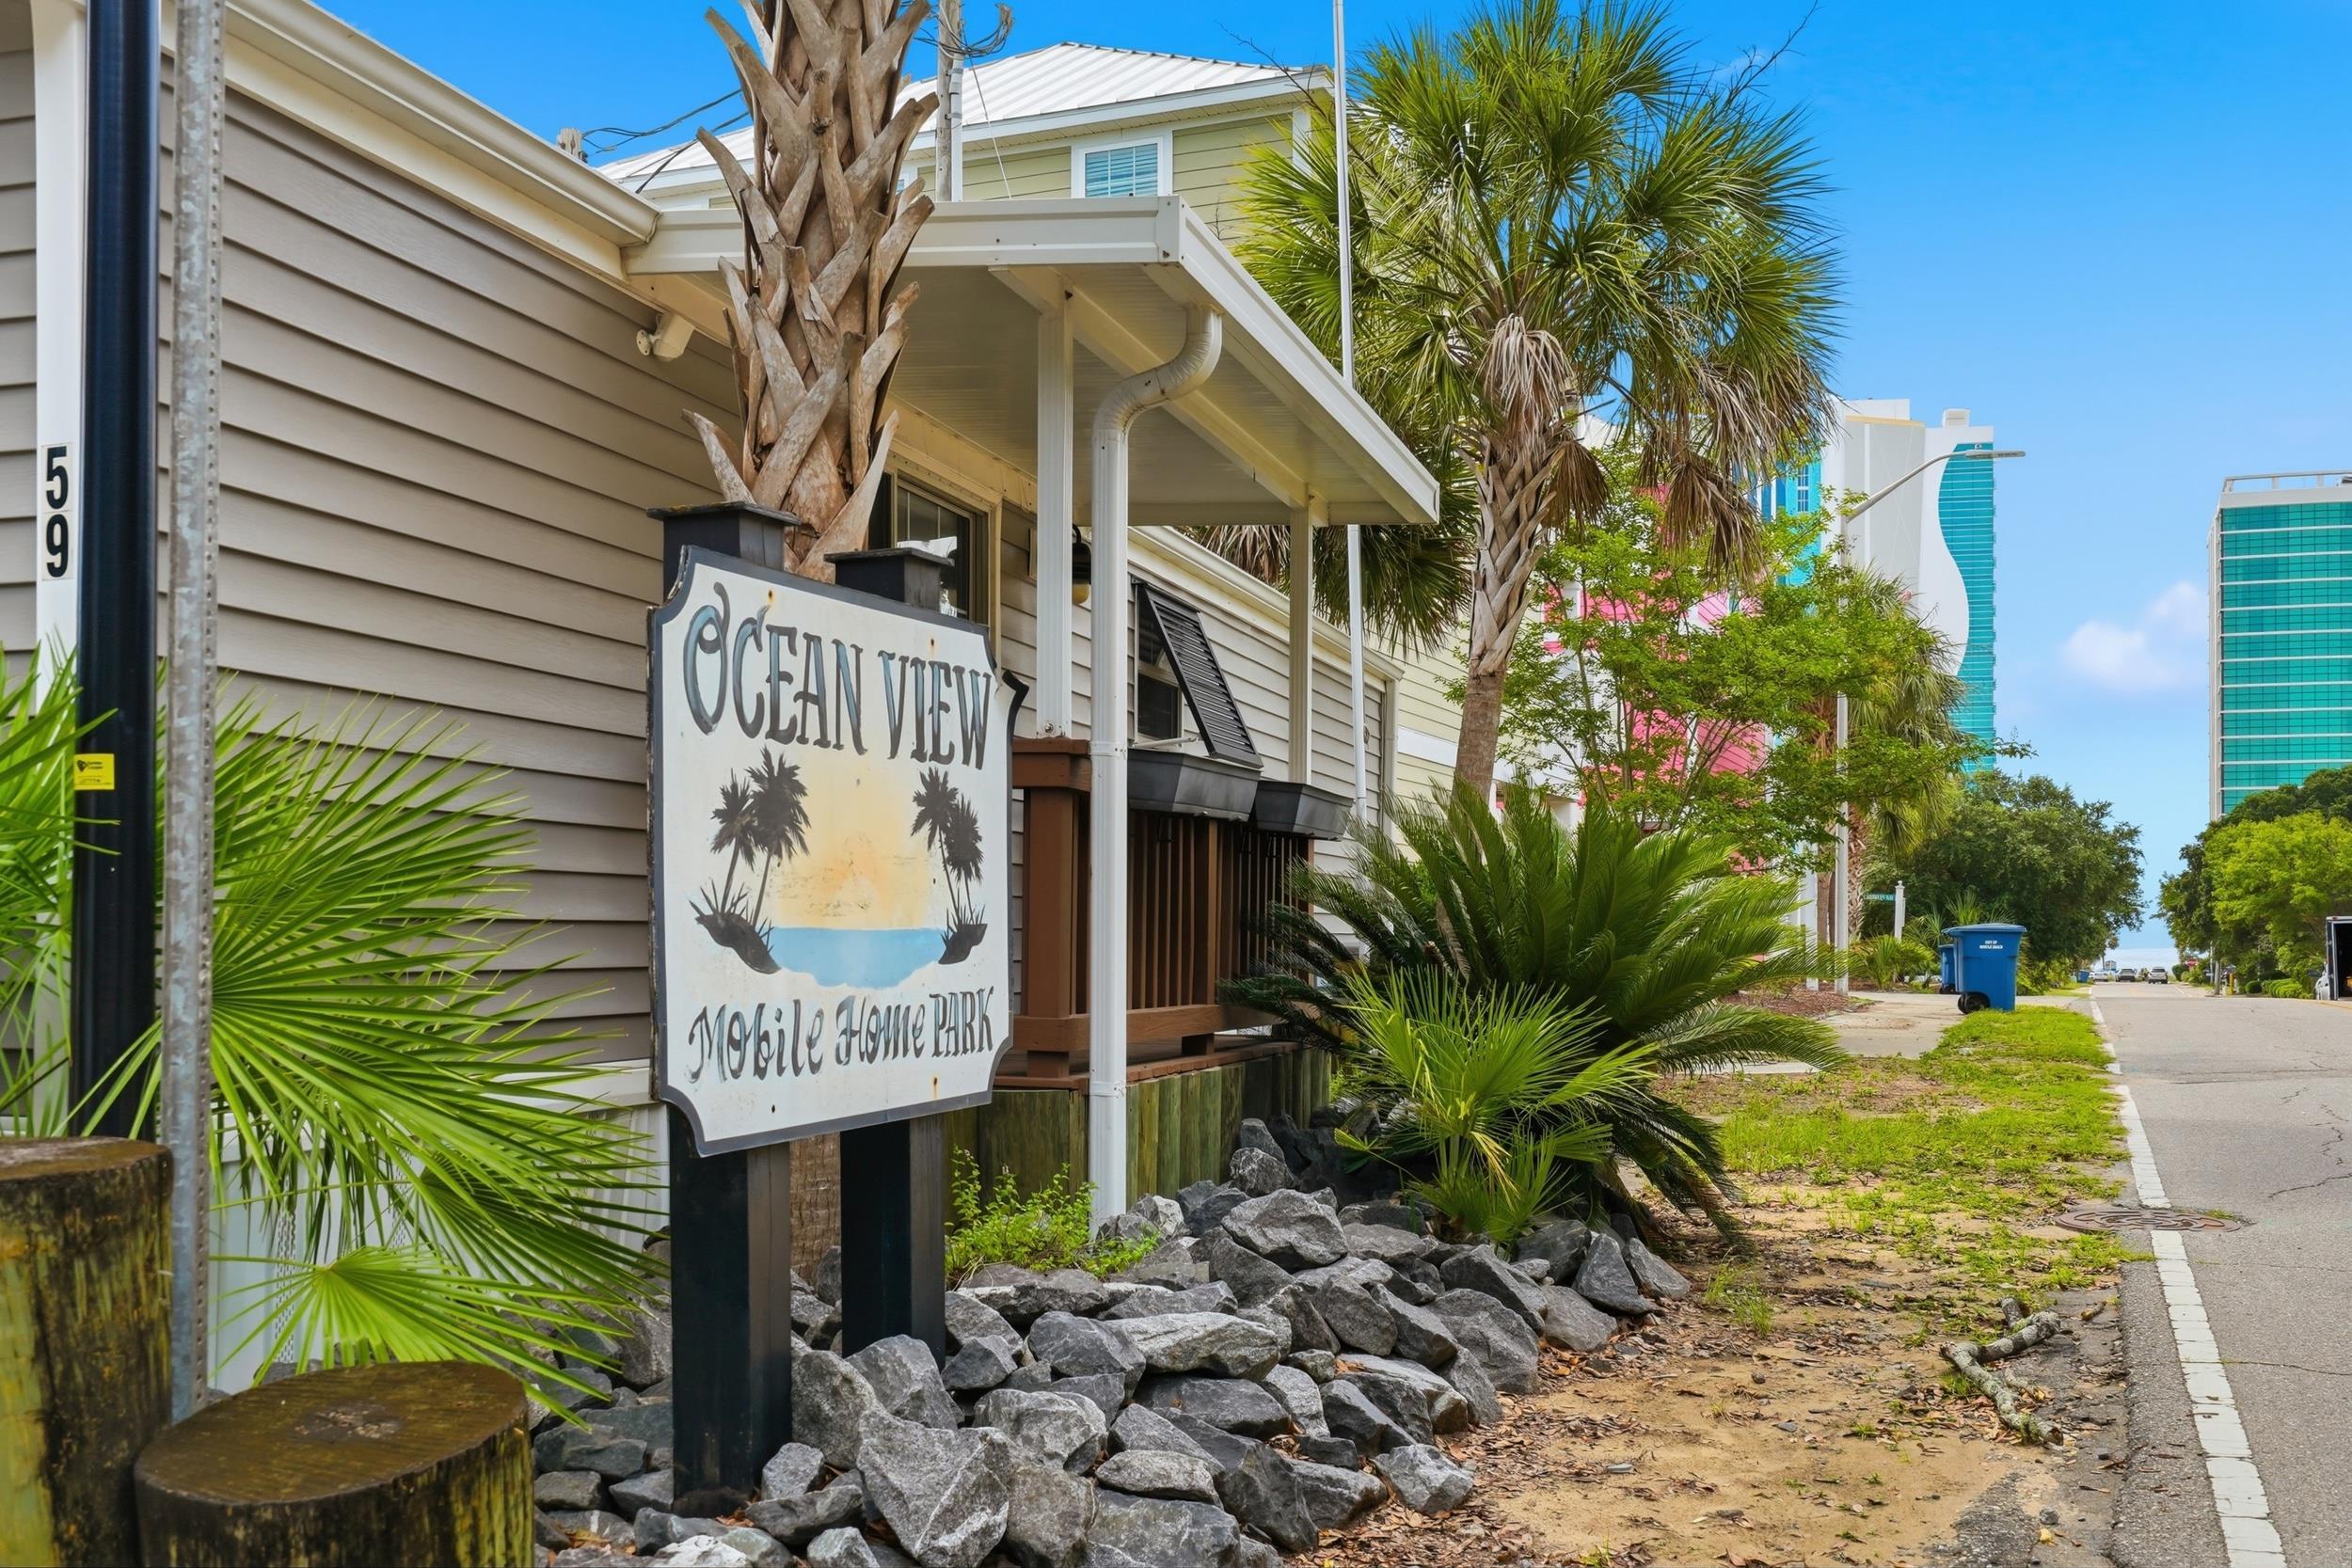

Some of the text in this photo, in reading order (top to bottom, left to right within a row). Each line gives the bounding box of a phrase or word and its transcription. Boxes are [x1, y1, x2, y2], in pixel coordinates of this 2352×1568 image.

[46, 446, 69, 578] 59
[683, 582, 992, 770] OCEAN VIEW
[688, 986, 993, 1084] Mobile Home PARK
